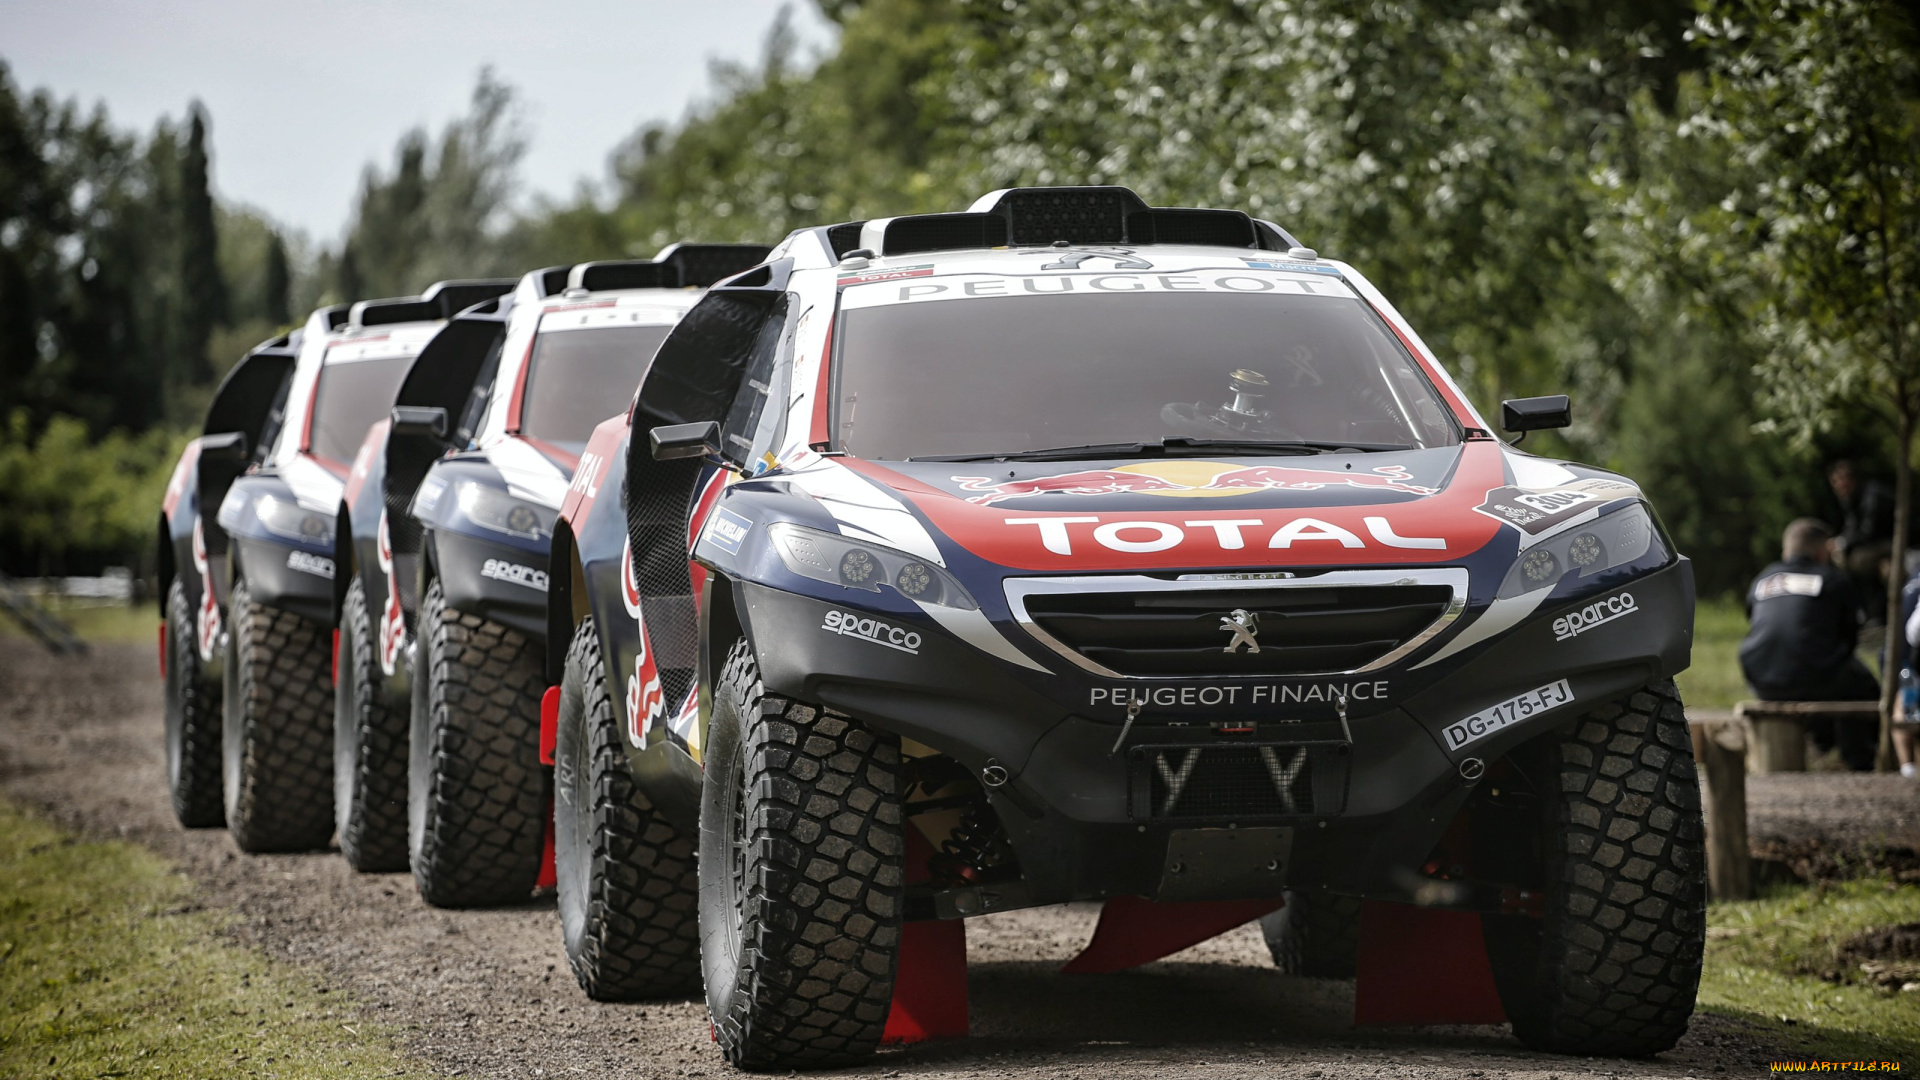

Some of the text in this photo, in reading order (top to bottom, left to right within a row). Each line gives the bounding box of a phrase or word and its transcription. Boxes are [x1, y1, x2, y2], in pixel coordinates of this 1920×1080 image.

[898, 275, 1324, 301] PEUGEOT
[1525, 491, 1588, 511] 304
[714, 517, 747, 543] MICHELIN
[1004, 516, 1448, 556] TOTAL
[481, 558, 549, 590] sparc
[822, 609, 922, 653] sparco
[1552, 592, 1638, 640] sparco
[1089, 681, 1389, 706] PEUGEOT FINANCE
[1448, 686, 1567, 747] DG-175-FJ
